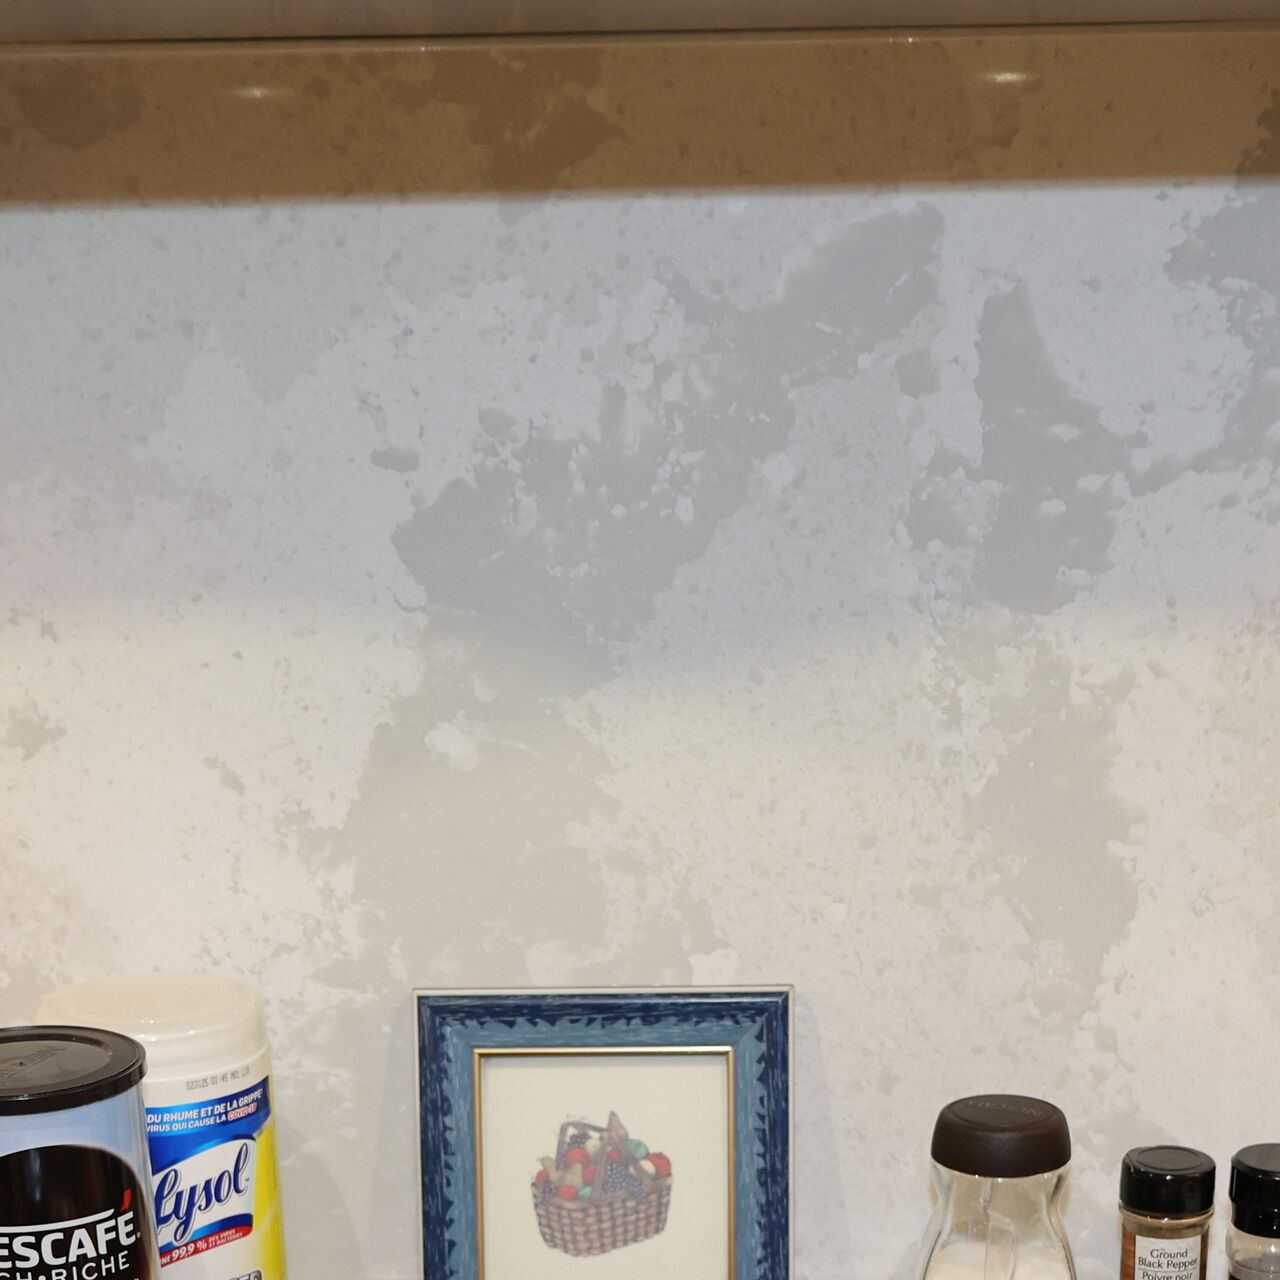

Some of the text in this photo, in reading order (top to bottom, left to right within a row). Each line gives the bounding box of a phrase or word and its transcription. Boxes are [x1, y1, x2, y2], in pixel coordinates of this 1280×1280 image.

[146, 1102, 257, 1132] VIRUS QUI CAUSE LA COVID-19
[147, 1114, 161, 1123] DU
[162, 1109, 199, 1122] RHUME
[201, 1106, 213, 1117] ET
[215, 1102, 226, 1114] DE
[227, 1100, 238, 1109] LA
[154, 1143, 248, 1242] Lysol
[172, 1243, 195, 1261] 99,9
[1150, 1248, 1188, 1259] Ground
[1138, 1257, 1198, 1271] Black Pepper
[1175, 1272, 1193, 1280] noir
